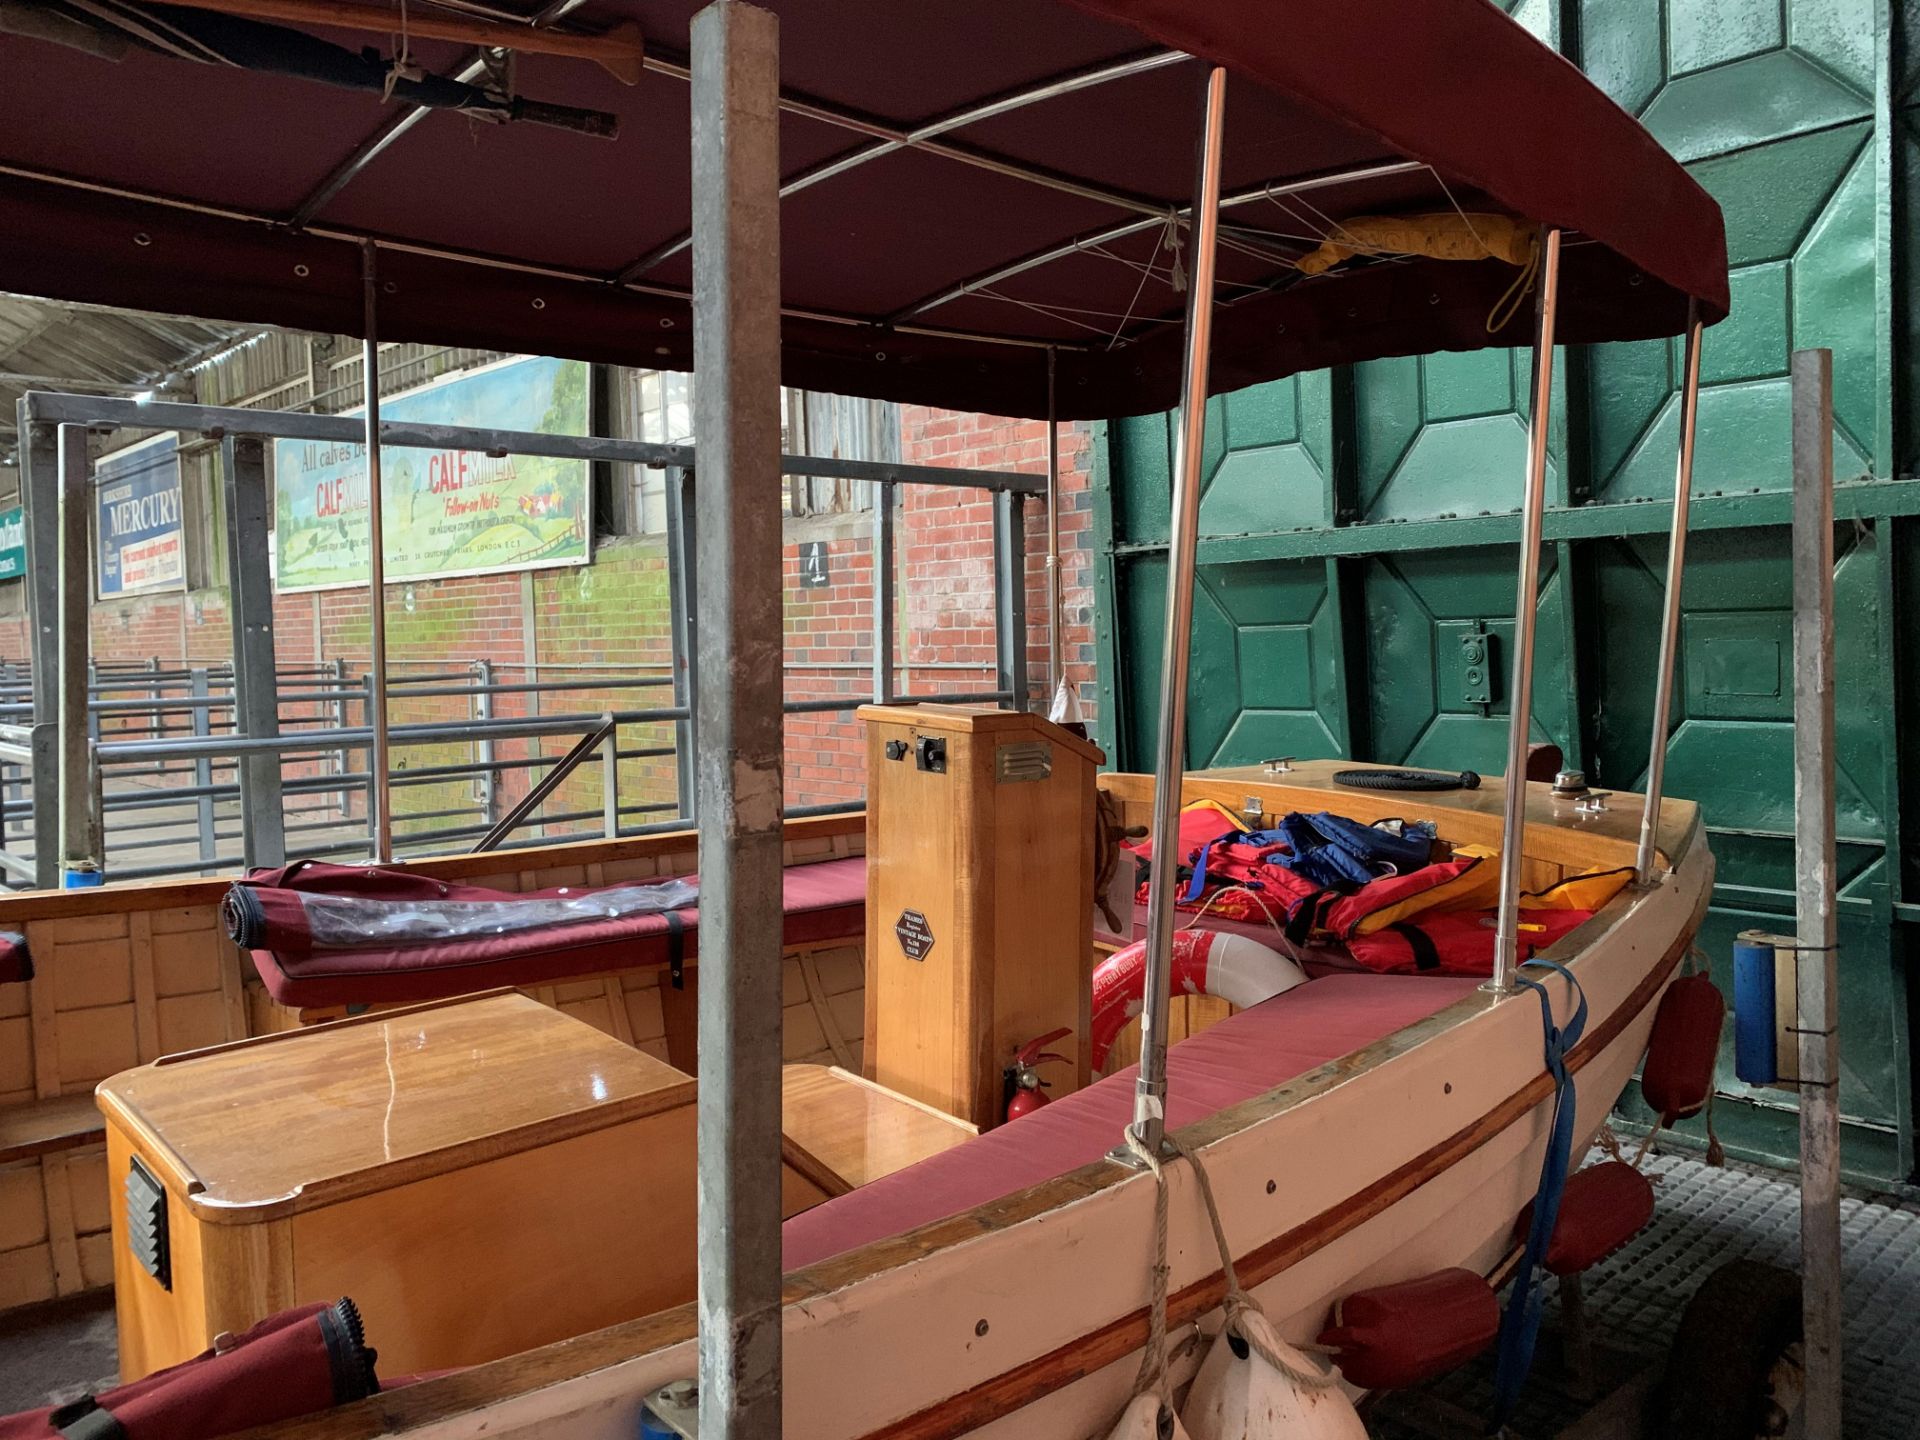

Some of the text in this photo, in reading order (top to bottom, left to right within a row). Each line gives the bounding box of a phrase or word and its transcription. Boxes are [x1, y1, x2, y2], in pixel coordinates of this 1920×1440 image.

[302, 443, 317, 473] All
[320, 441, 351, 468] calves
[110, 487, 181, 537] MERCURY
[477, 543, 502, 552] LONDON
